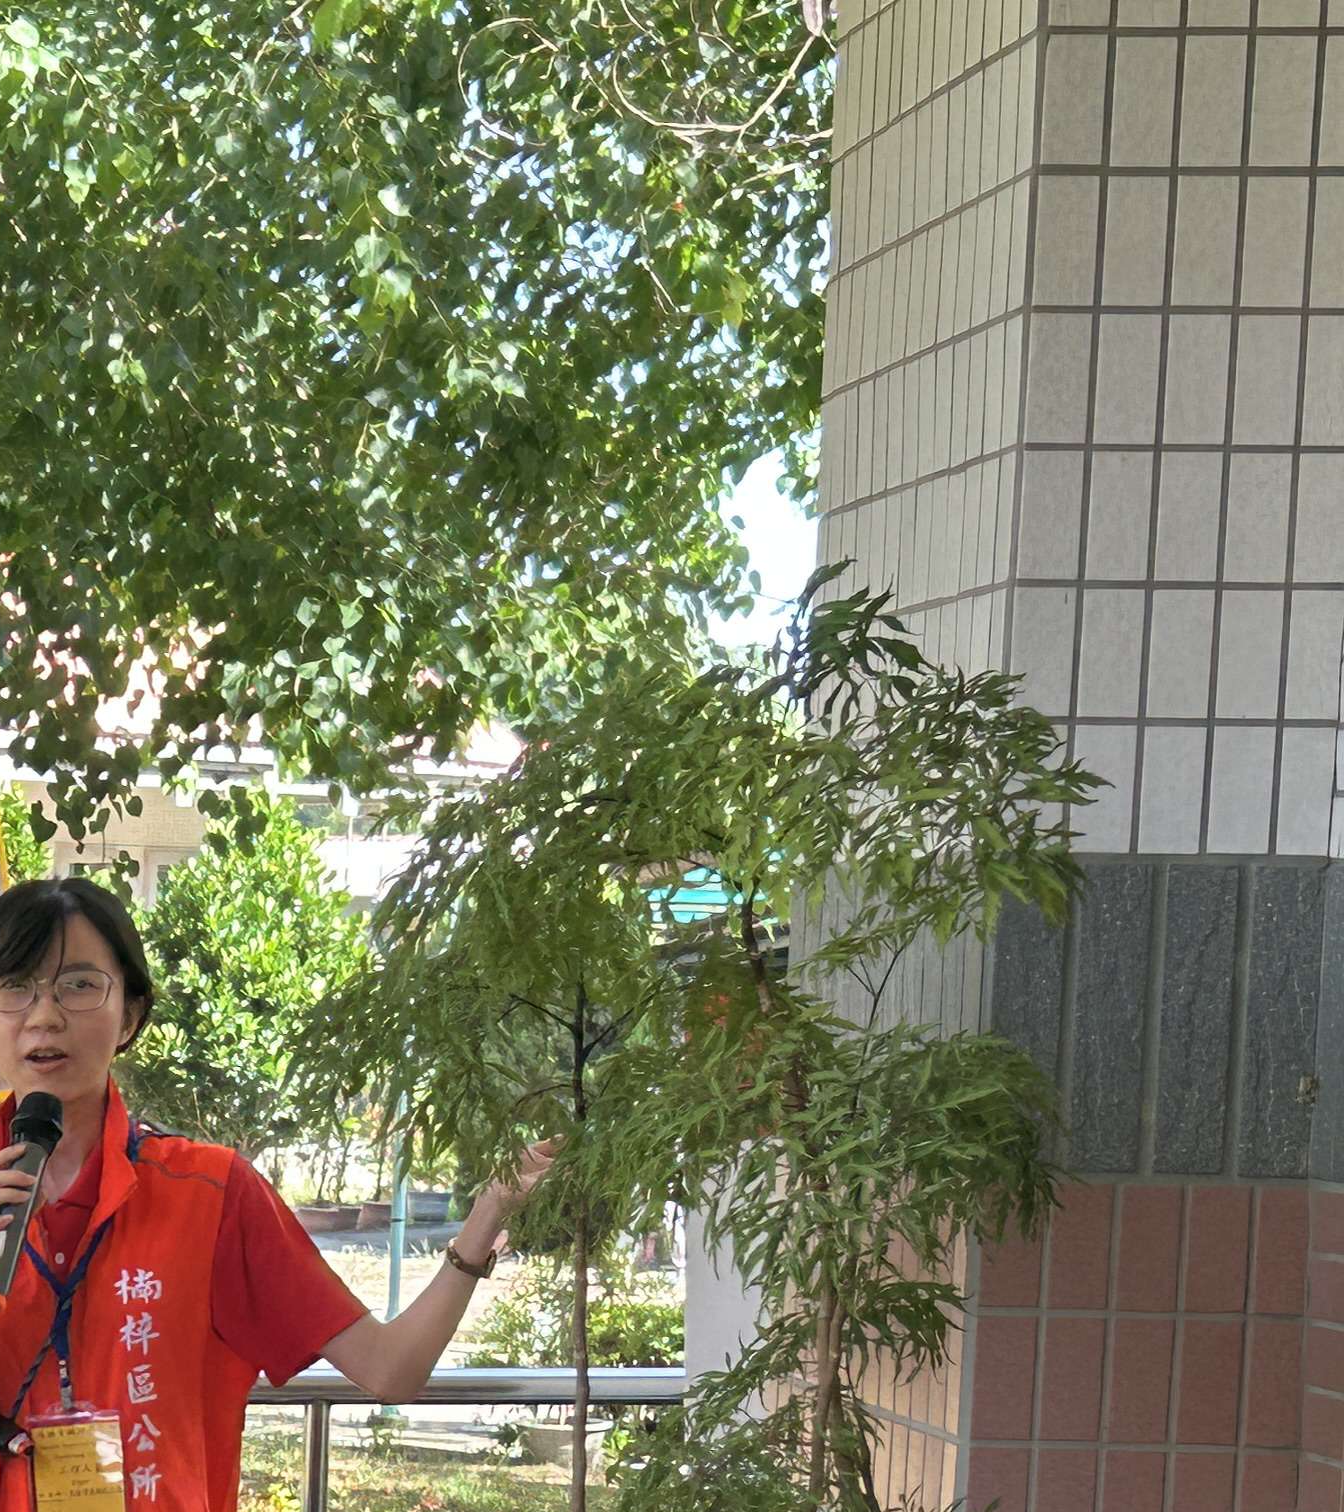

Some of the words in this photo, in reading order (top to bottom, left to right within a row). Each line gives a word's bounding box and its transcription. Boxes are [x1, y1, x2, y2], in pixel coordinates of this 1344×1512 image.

[113, 1268, 163, 1503] 楠梓區公所
